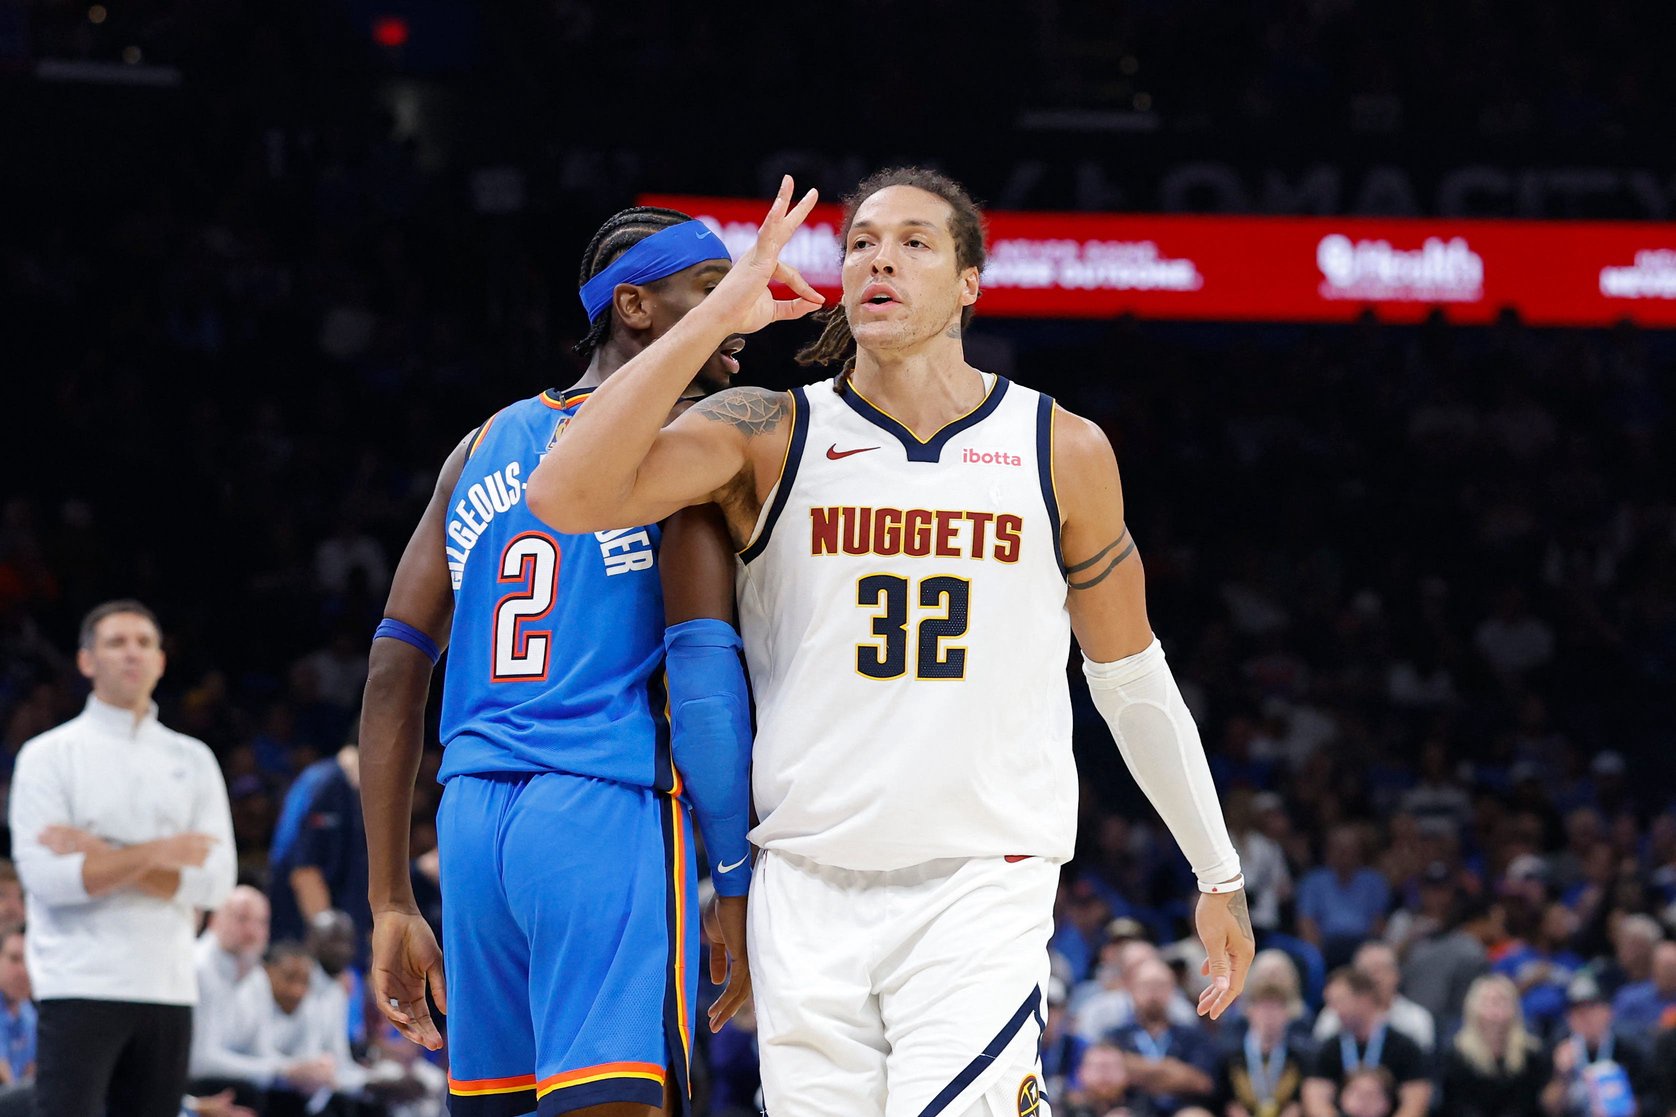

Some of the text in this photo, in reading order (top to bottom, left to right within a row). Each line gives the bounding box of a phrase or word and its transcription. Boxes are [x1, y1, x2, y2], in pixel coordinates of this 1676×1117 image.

[962, 447, 1022, 467] ibotta
[809, 505, 1024, 564] NUGGETS
[491, 530, 561, 684] 2
[854, 571, 973, 682] 32
